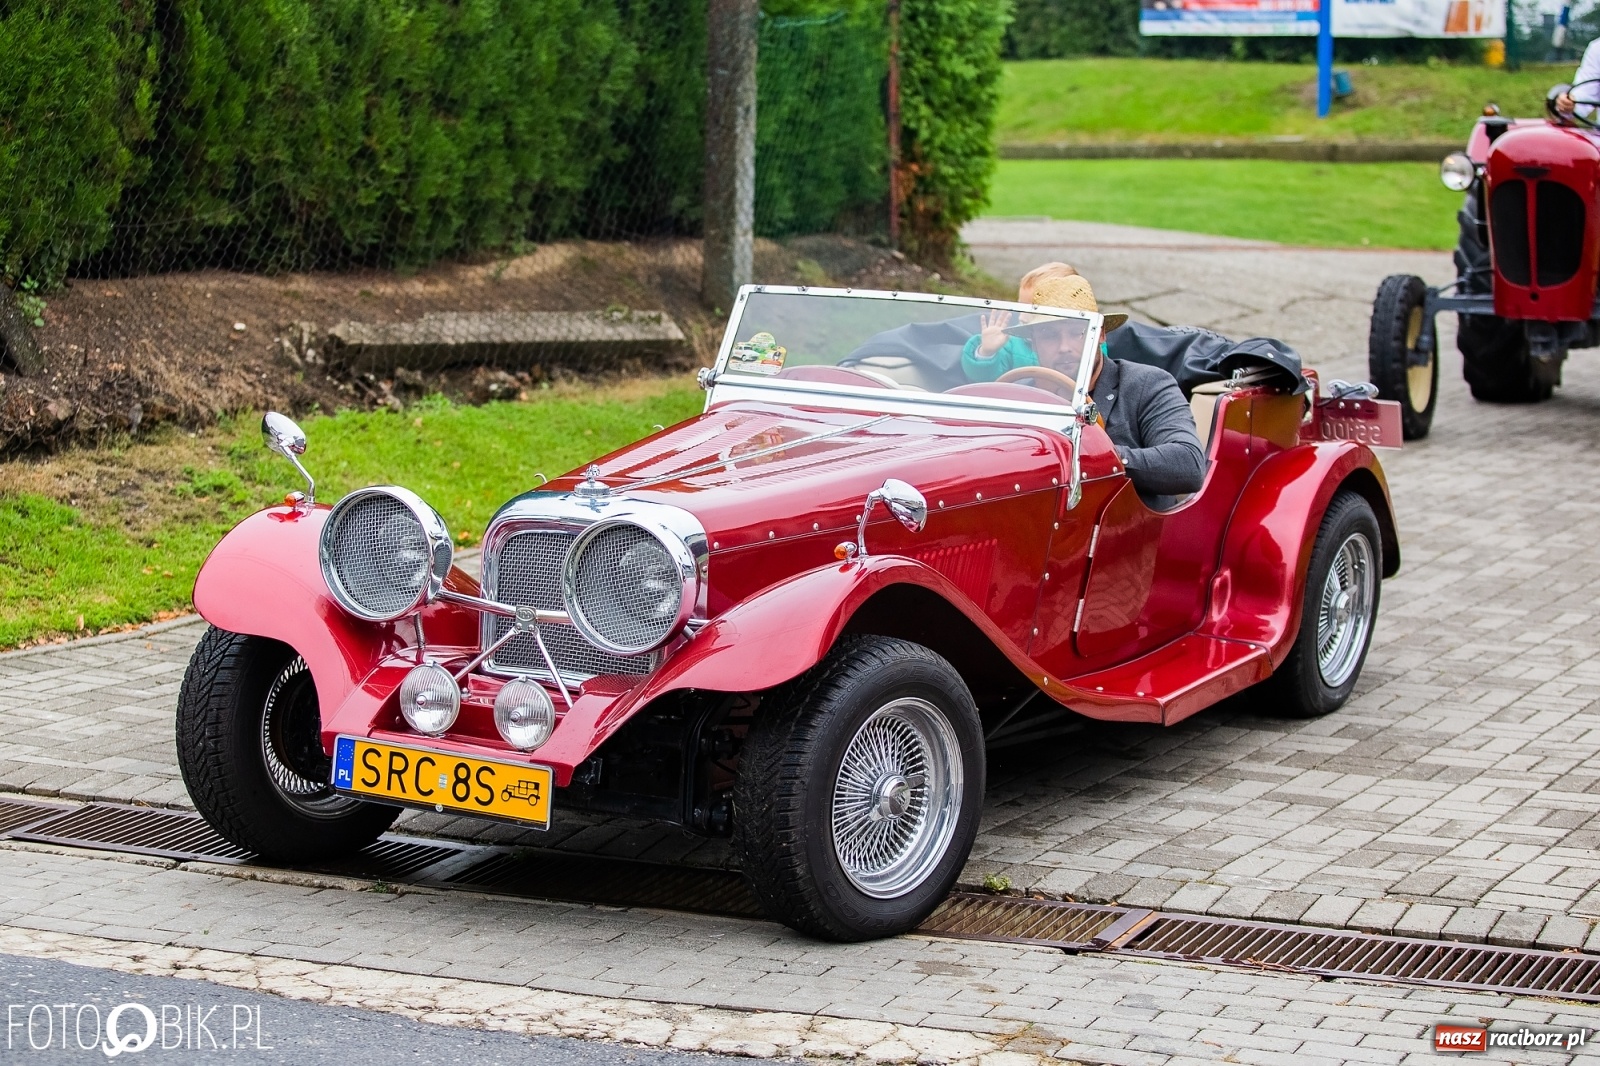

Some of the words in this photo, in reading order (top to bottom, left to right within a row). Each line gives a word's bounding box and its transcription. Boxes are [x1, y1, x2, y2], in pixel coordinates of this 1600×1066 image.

[338, 768, 351, 782] PL
[361, 747, 437, 797] SRC
[451, 762, 496, 807] 8S
